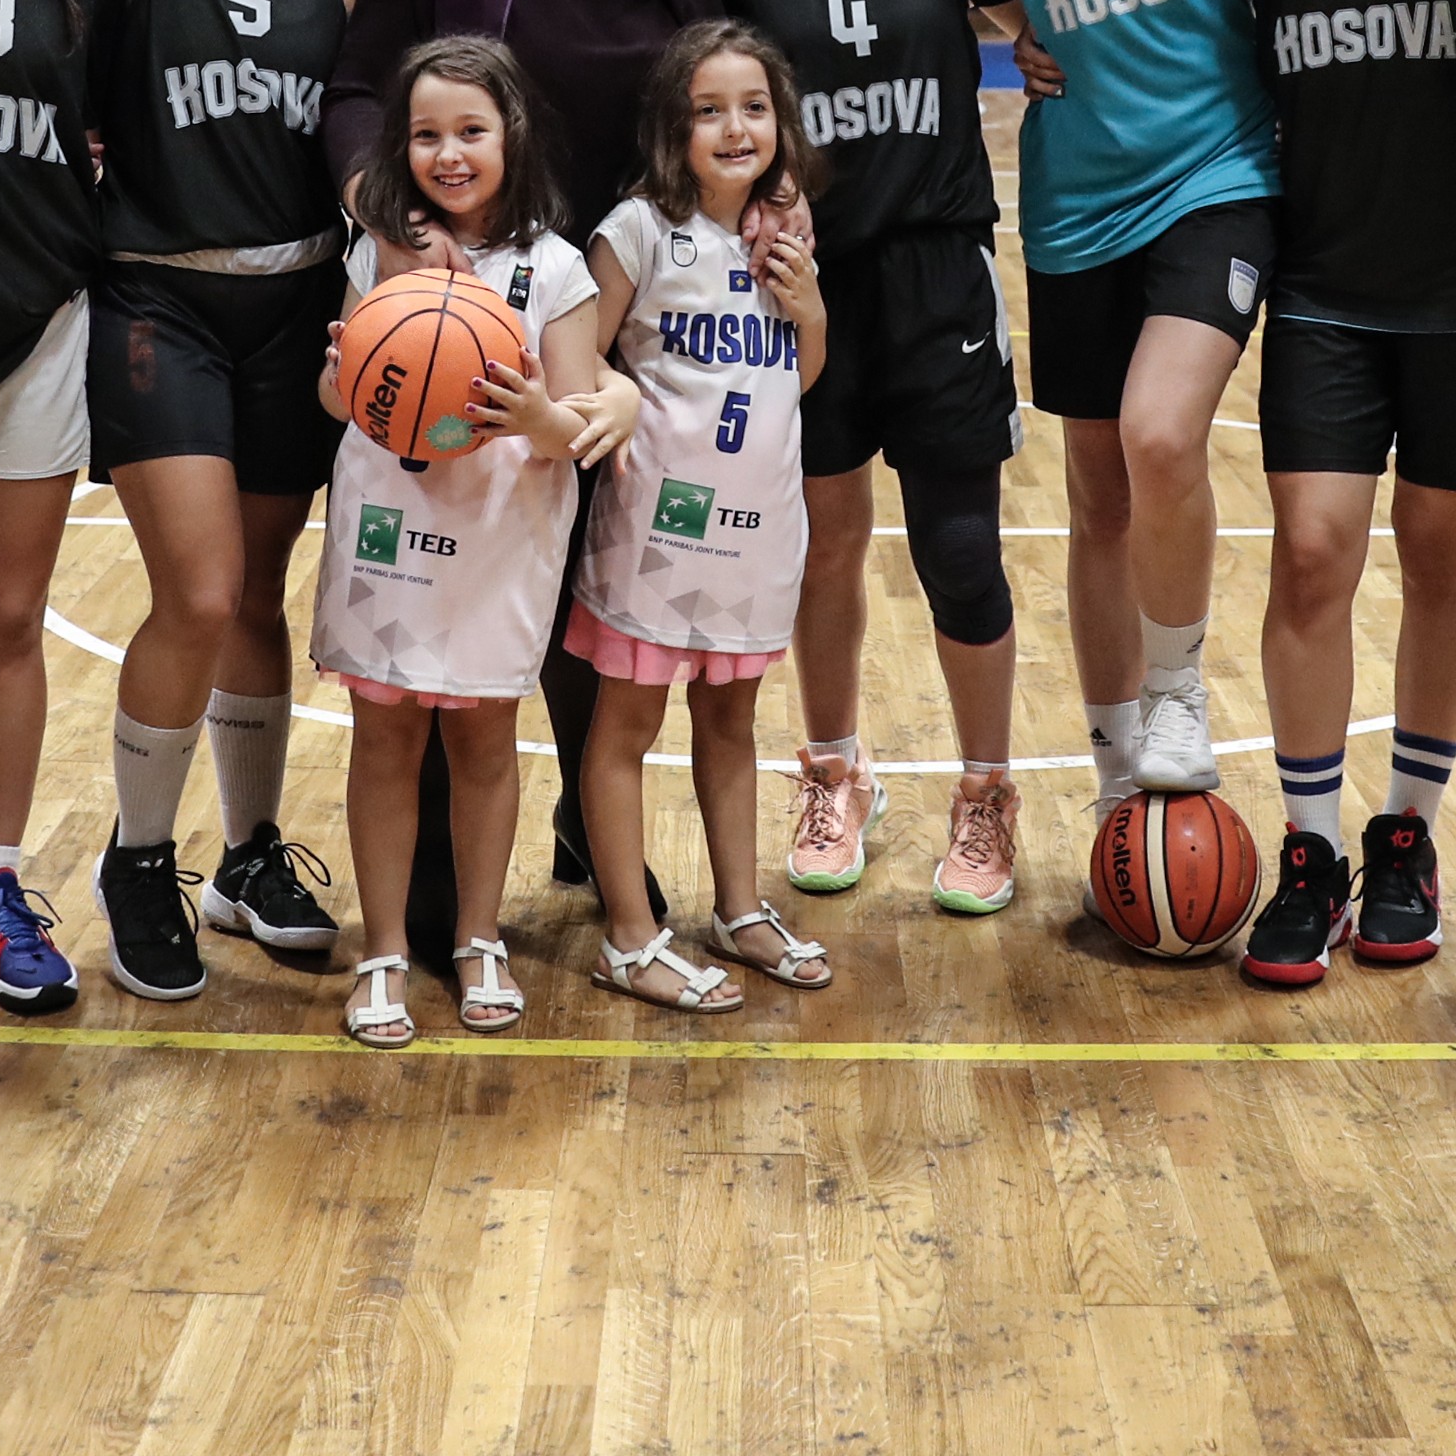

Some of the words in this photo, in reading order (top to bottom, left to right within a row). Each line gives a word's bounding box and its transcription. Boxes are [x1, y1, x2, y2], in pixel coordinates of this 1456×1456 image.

[163, 57, 325, 136] KOSOVA
[799, 77, 941, 148] OSOVA
[659, 311, 800, 372] KOSOVA
[715, 390, 751, 455] 5
[406, 530, 458, 557] TEB
[717, 507, 761, 529] TEB
[365, 567, 389, 579] PARIBAS
[664, 539, 694, 552] PARIBAS
[694, 545, 714, 555] JOINT
[715, 548, 742, 559] VENTURE
[1111, 807, 1137, 908] molten
